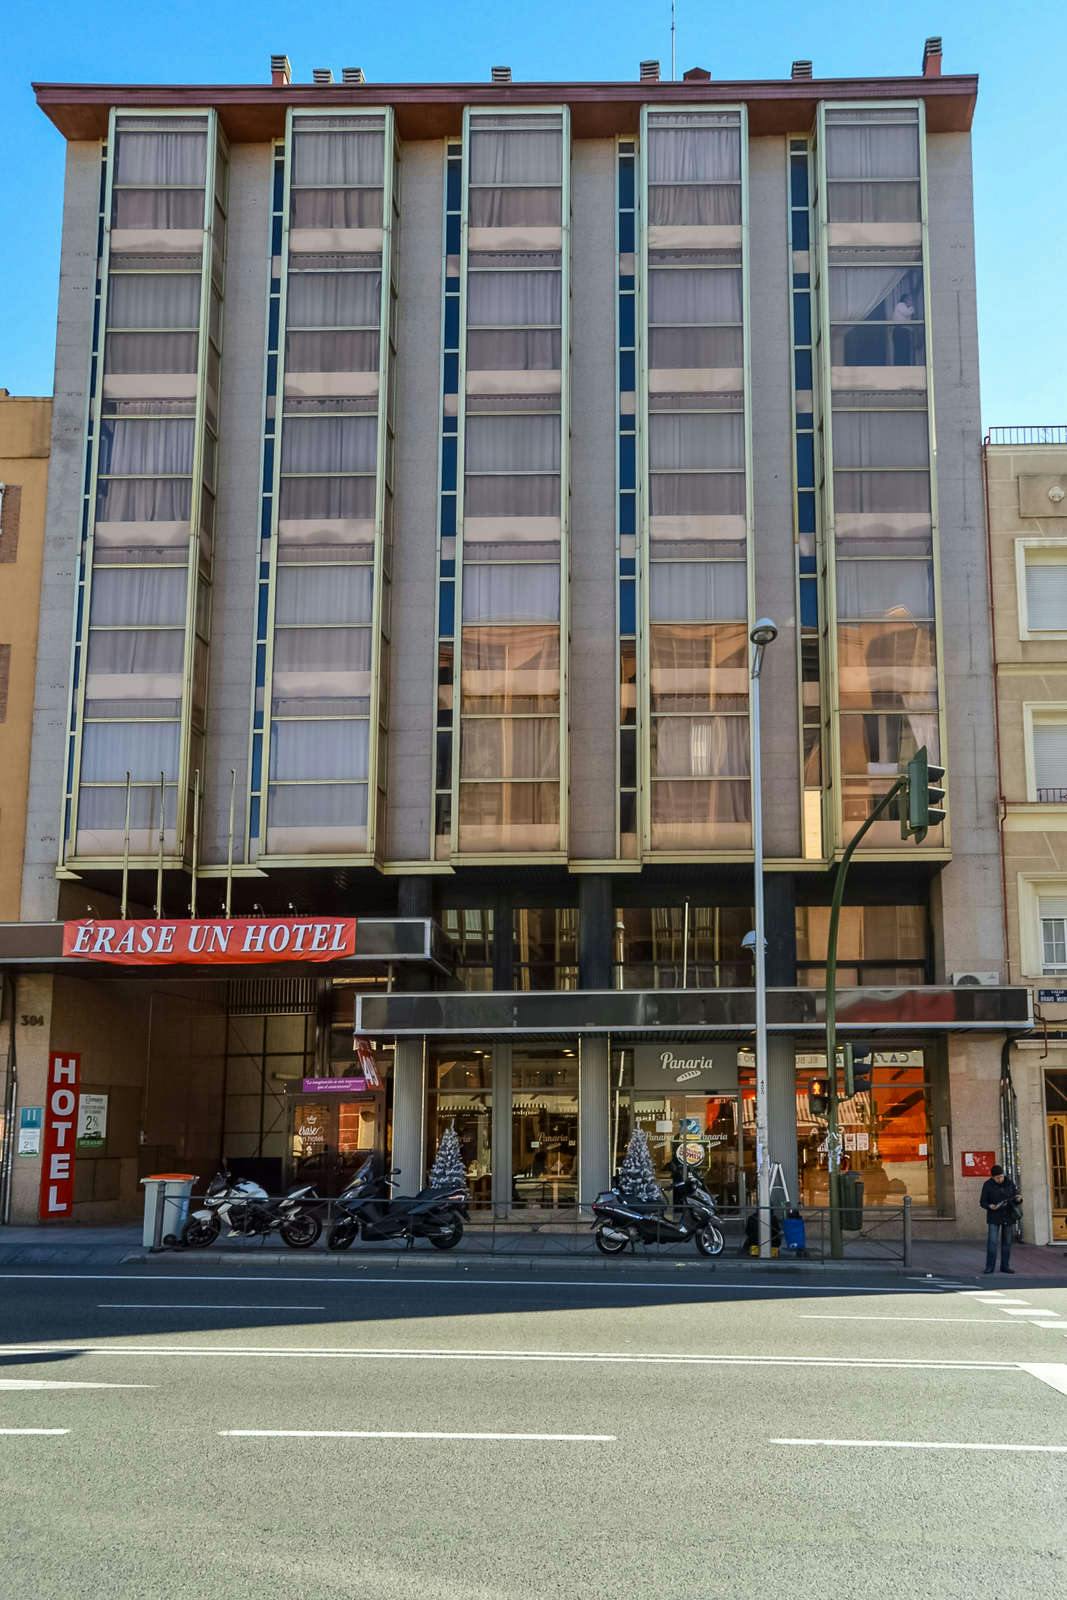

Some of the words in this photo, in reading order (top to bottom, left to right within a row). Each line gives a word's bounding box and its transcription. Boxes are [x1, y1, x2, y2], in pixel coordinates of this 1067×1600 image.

[71, 920, 176, 953] ÉRASE
[187, 924, 234, 953] UN
[240, 923, 347, 953] HOTEL
[20, 1014, 45, 1026] 304
[660, 1051, 713, 1069] Panaria
[48, 1058, 77, 1212] HOTEL
